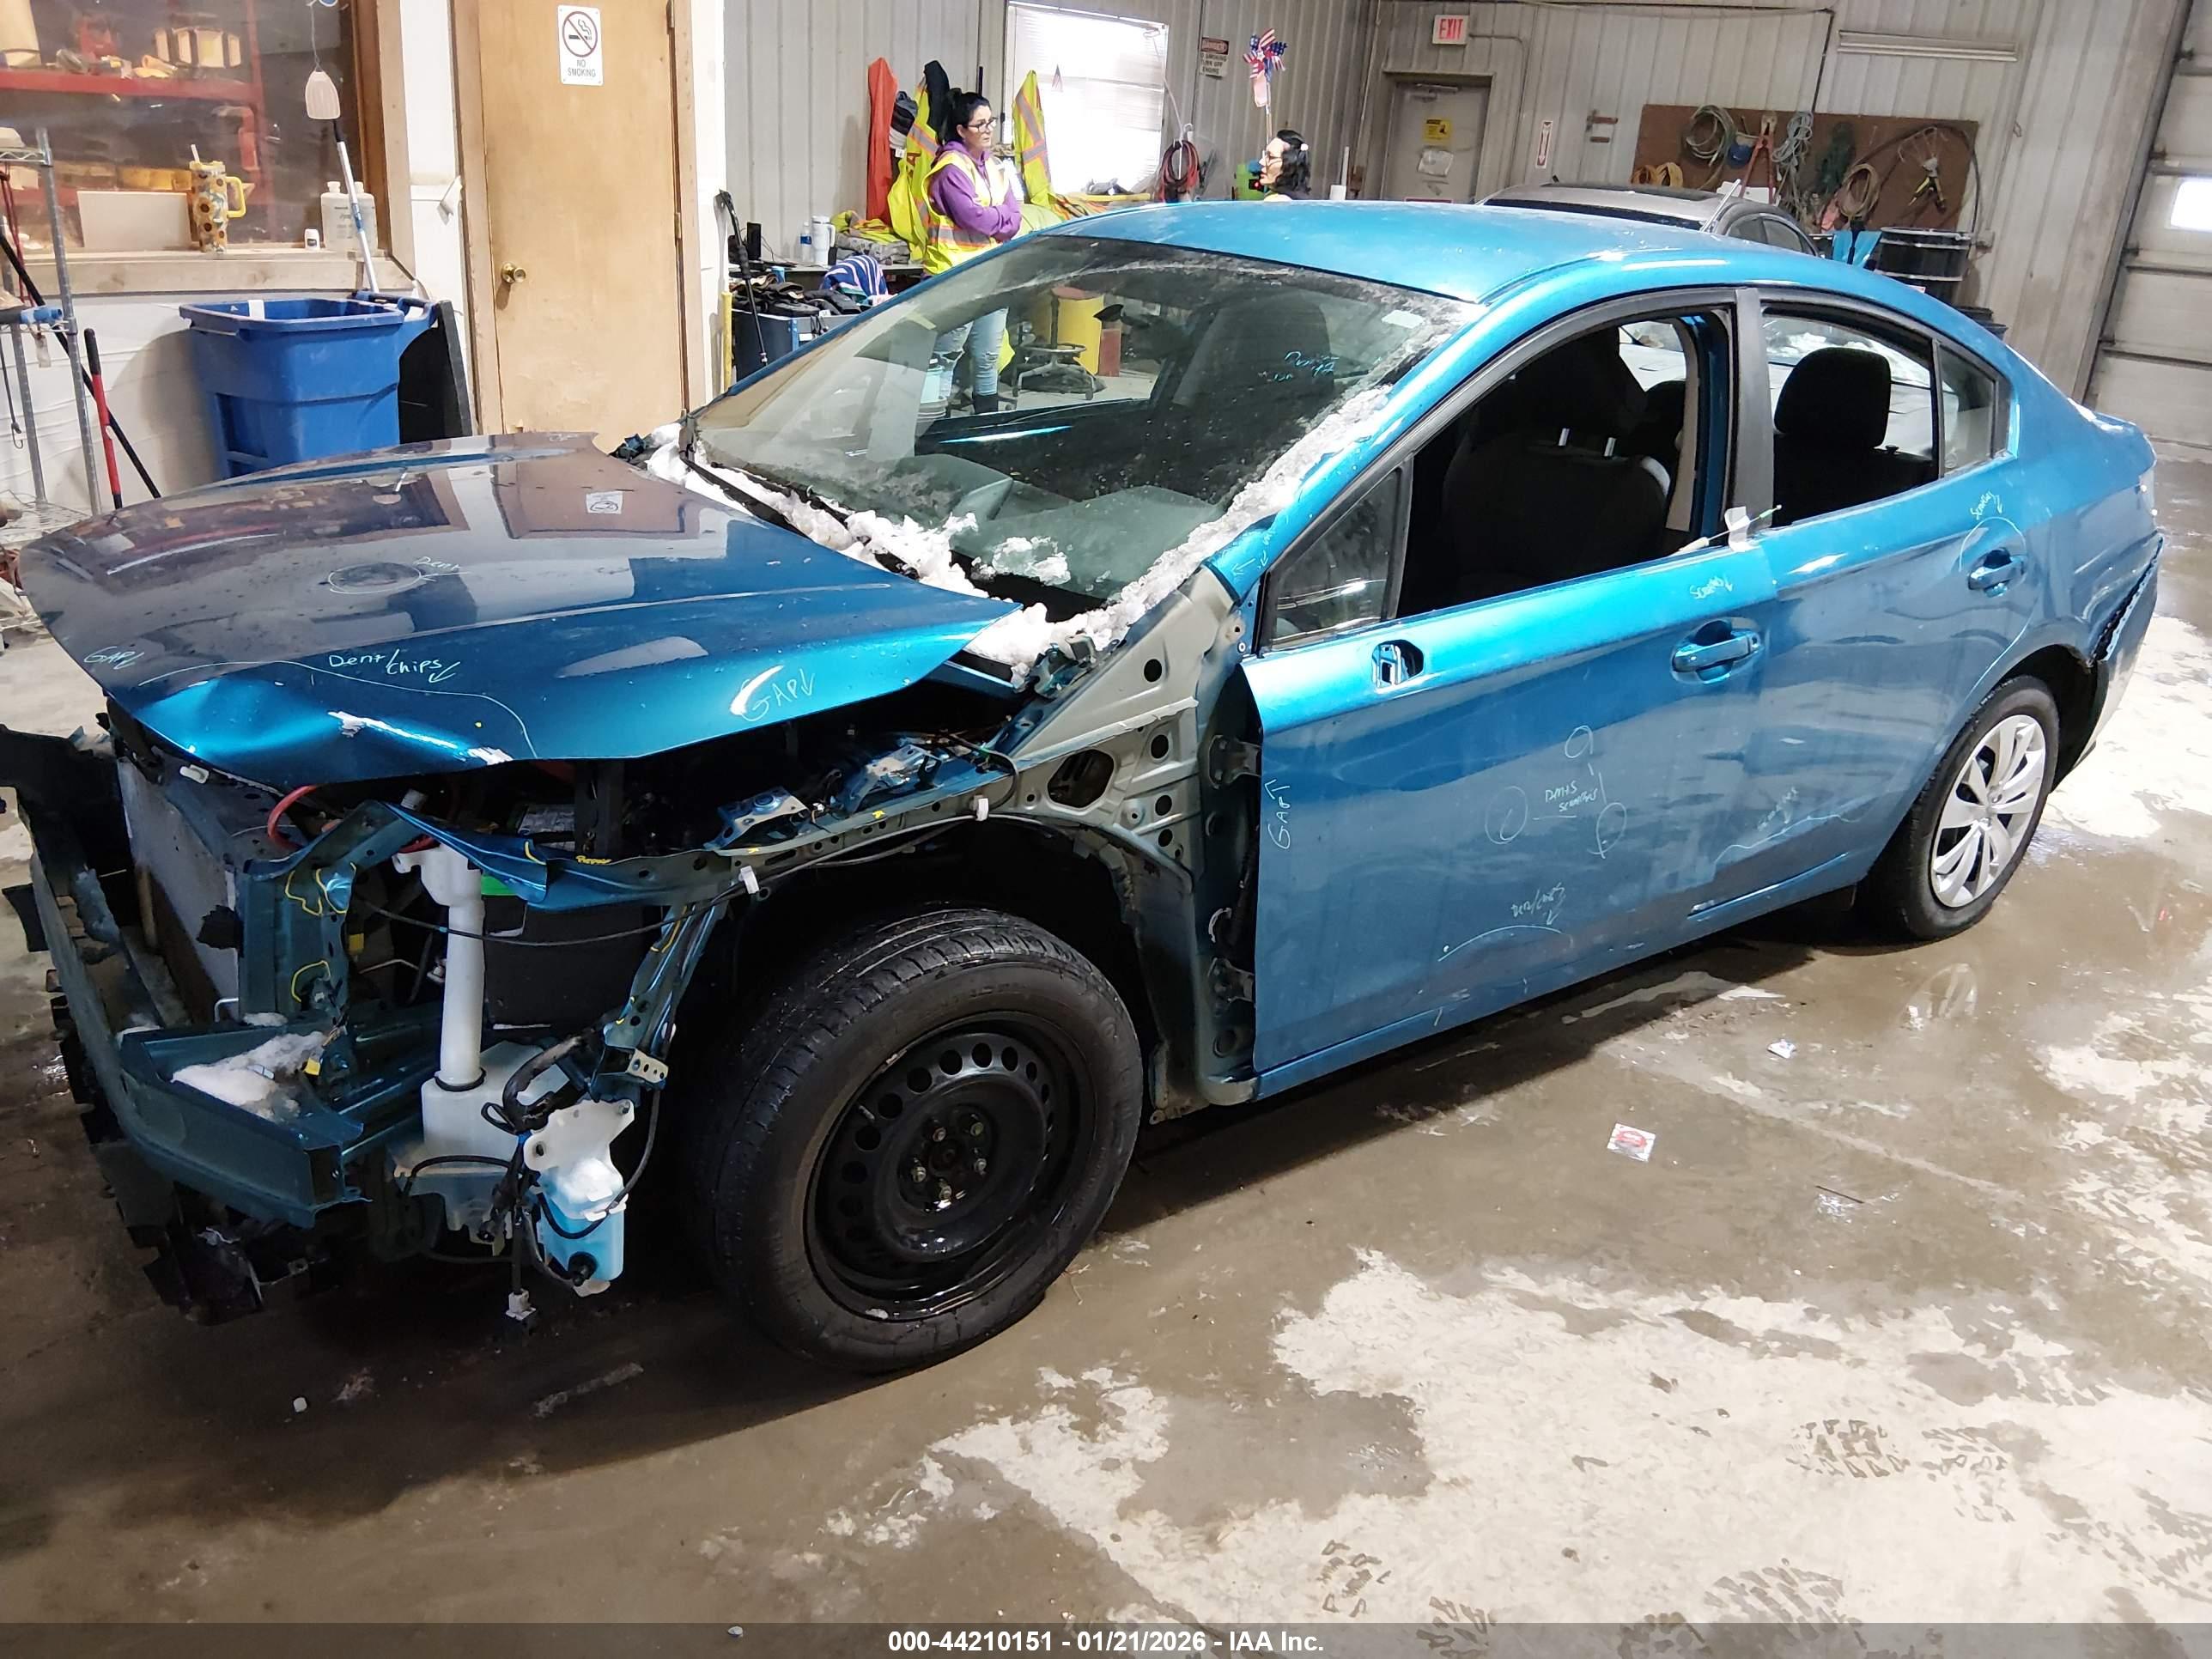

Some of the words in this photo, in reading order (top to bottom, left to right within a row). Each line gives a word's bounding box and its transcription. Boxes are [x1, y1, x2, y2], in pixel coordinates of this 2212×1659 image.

[1439, 18, 1464, 40] EXIT
[576, 59, 586, 68] NO
[567, 67, 597, 77] SMOKING
